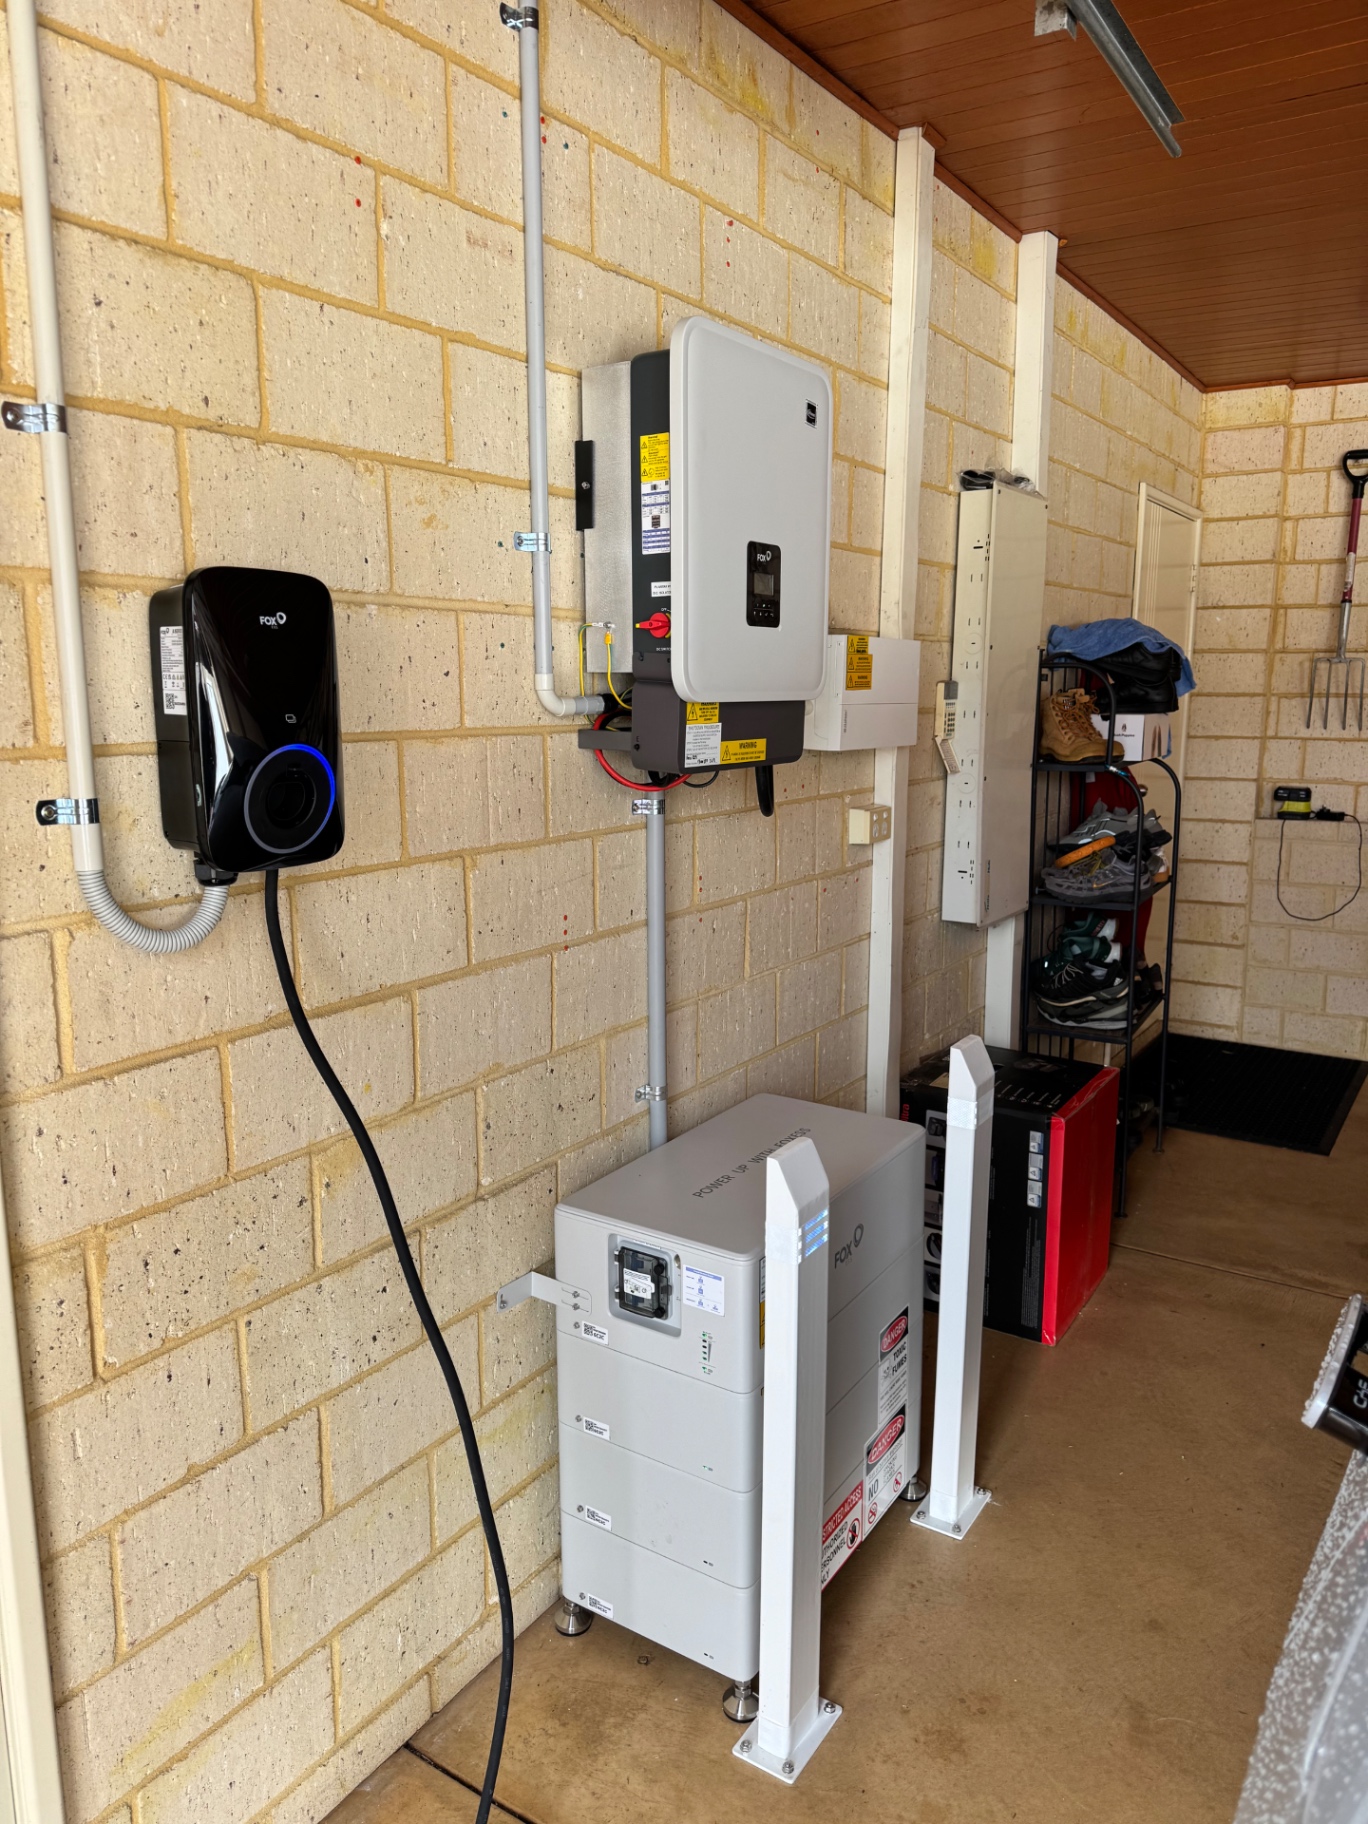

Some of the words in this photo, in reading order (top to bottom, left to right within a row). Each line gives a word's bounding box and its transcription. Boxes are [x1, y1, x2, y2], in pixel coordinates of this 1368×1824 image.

[692, 1174, 736, 1198] POWER
[731, 1164, 749, 1173] UP
[747, 1148, 776, 1164] WITH
[882, 1318, 906, 1350] DANGER
[871, 1418, 903, 1461] DANGER
[868, 1478, 879, 1500] NO
[821, 1521, 848, 1558] THORIZED
[822, 1505, 846, 1541] STRICTED
[821, 1536, 847, 1573] ERSONNEL
